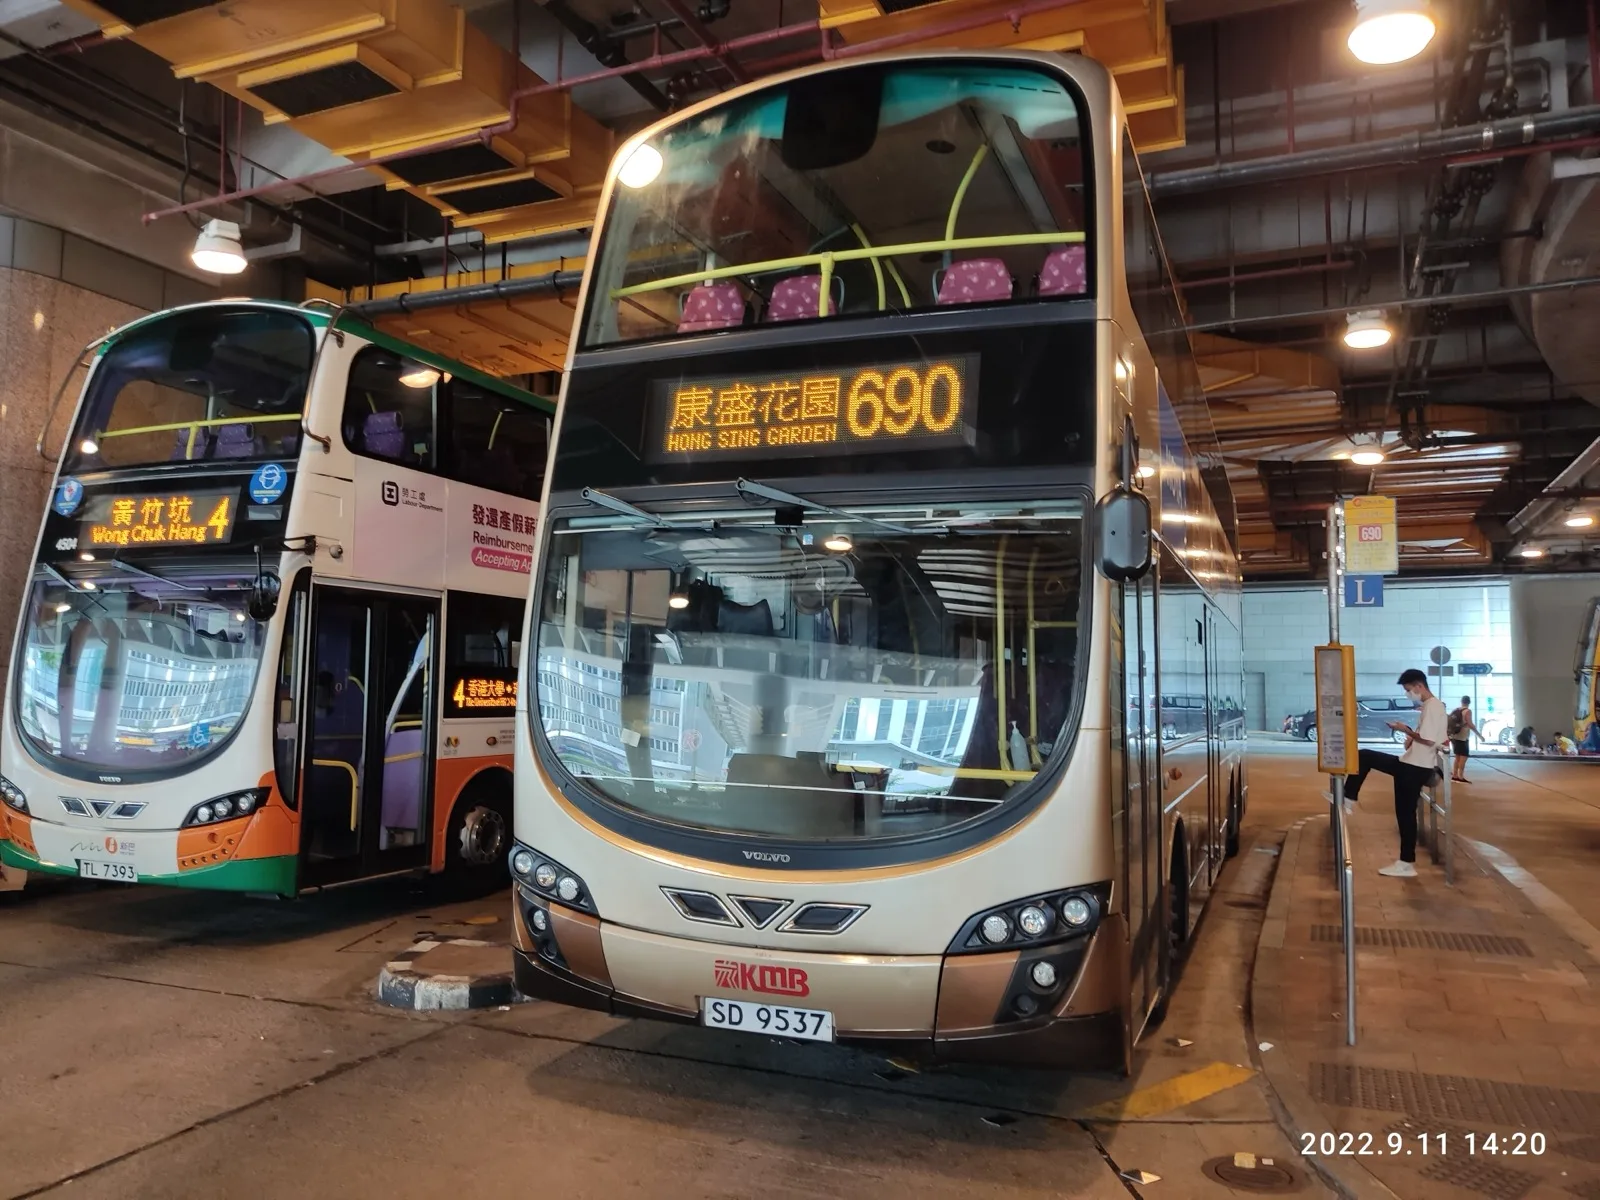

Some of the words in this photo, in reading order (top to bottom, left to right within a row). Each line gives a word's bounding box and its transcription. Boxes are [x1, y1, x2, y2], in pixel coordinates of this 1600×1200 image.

[669, 376, 840, 430] 康盛花園
[846, 364, 960, 437] 690
[668, 430, 712, 451] HONG
[716, 427, 761, 449] SING
[766, 423, 838, 446] GARDEN
[113, 498, 193, 525] 黃竹坑
[208, 497, 230, 539] 4
[419, 502, 443, 512] Department
[472, 504, 538, 536] 發還產假薪
[55, 537, 78, 551] 4504
[93, 526, 130, 545] Wong
[131, 525, 166, 542] Chuk
[168, 523, 207, 543] Hang
[1361, 526, 1382, 541] 690
[475, 551, 520, 570] Accepting
[1354, 580, 1375, 604] L
[453, 679, 465, 708] 4
[742, 850, 791, 863] VOLVO
[83, 862, 98, 876] TL
[103, 864, 135, 879] 7393
[740, 962, 810, 998] KMB
[711, 1001, 743, 1026] SD
[756, 1007, 825, 1036] 9537
